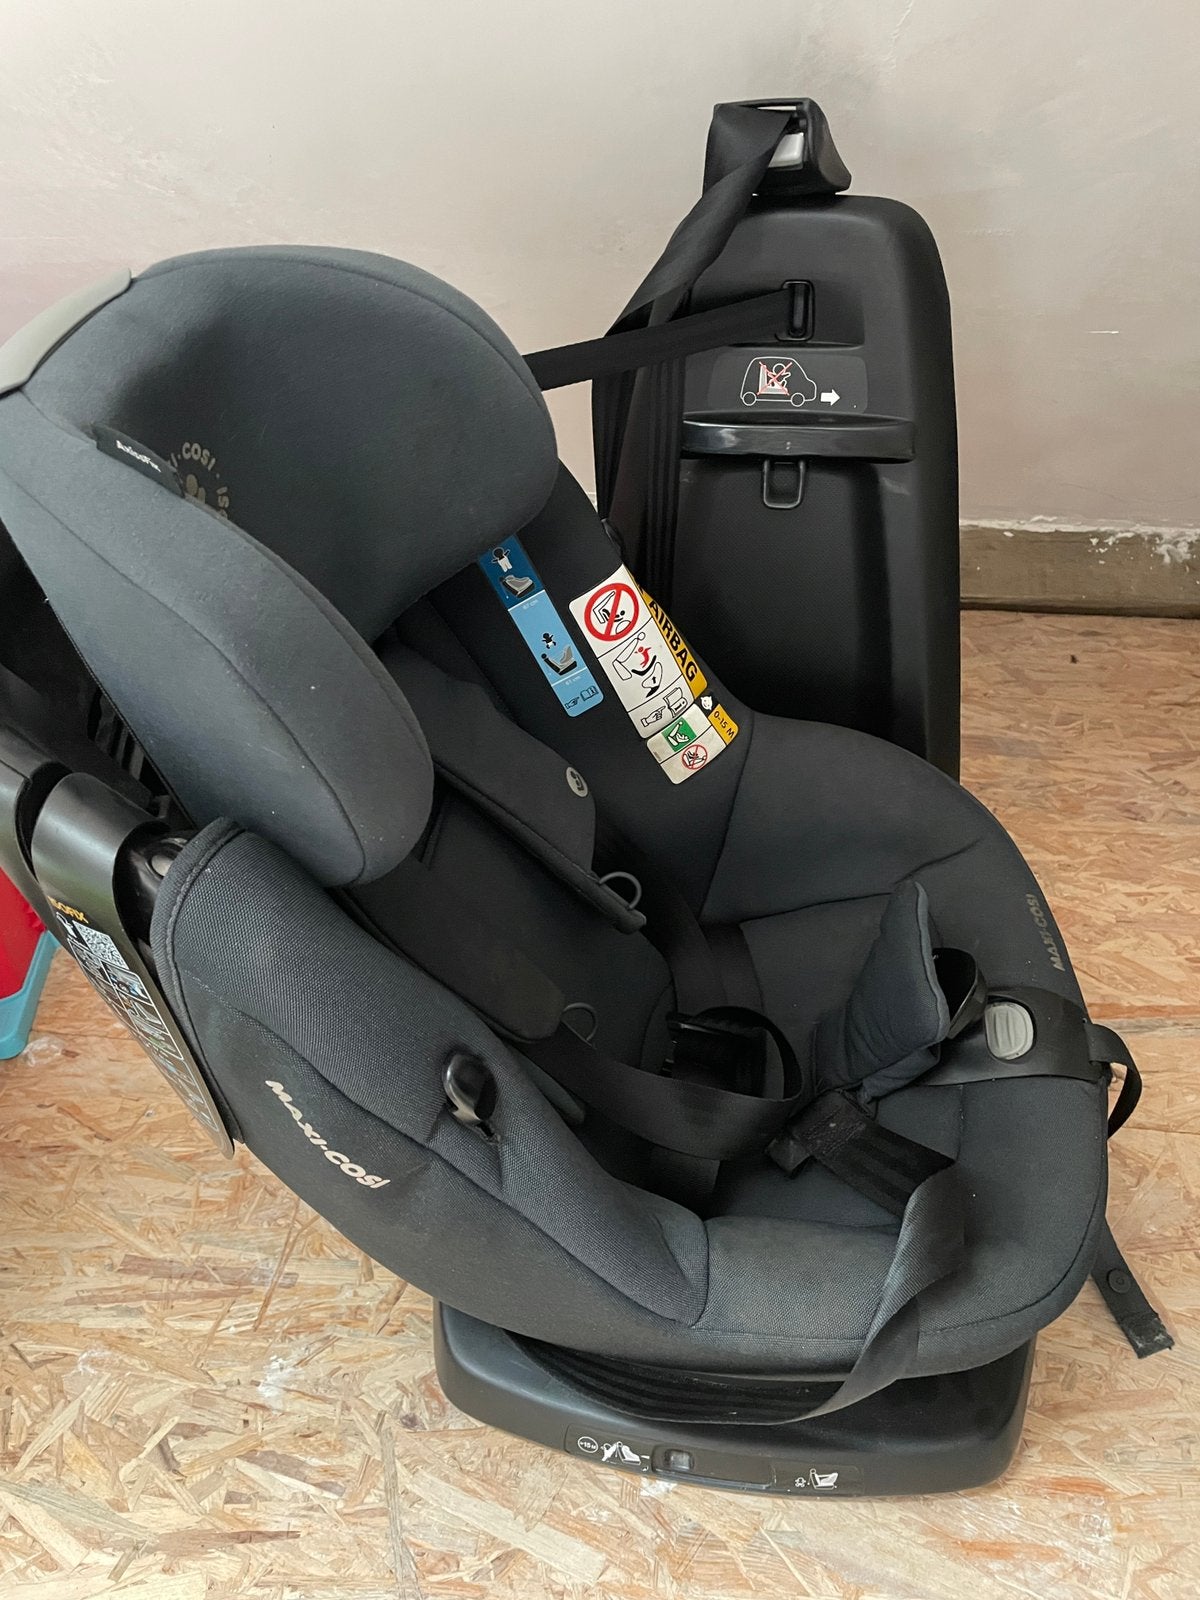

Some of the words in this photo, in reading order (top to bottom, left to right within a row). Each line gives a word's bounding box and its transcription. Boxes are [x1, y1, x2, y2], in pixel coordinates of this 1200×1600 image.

[648, 600, 698, 682] AIRBAG
[713, 710, 728, 729] 0-15
[726, 727, 735, 738] M
[264, 1080, 391, 1189] MAXI-COSI
